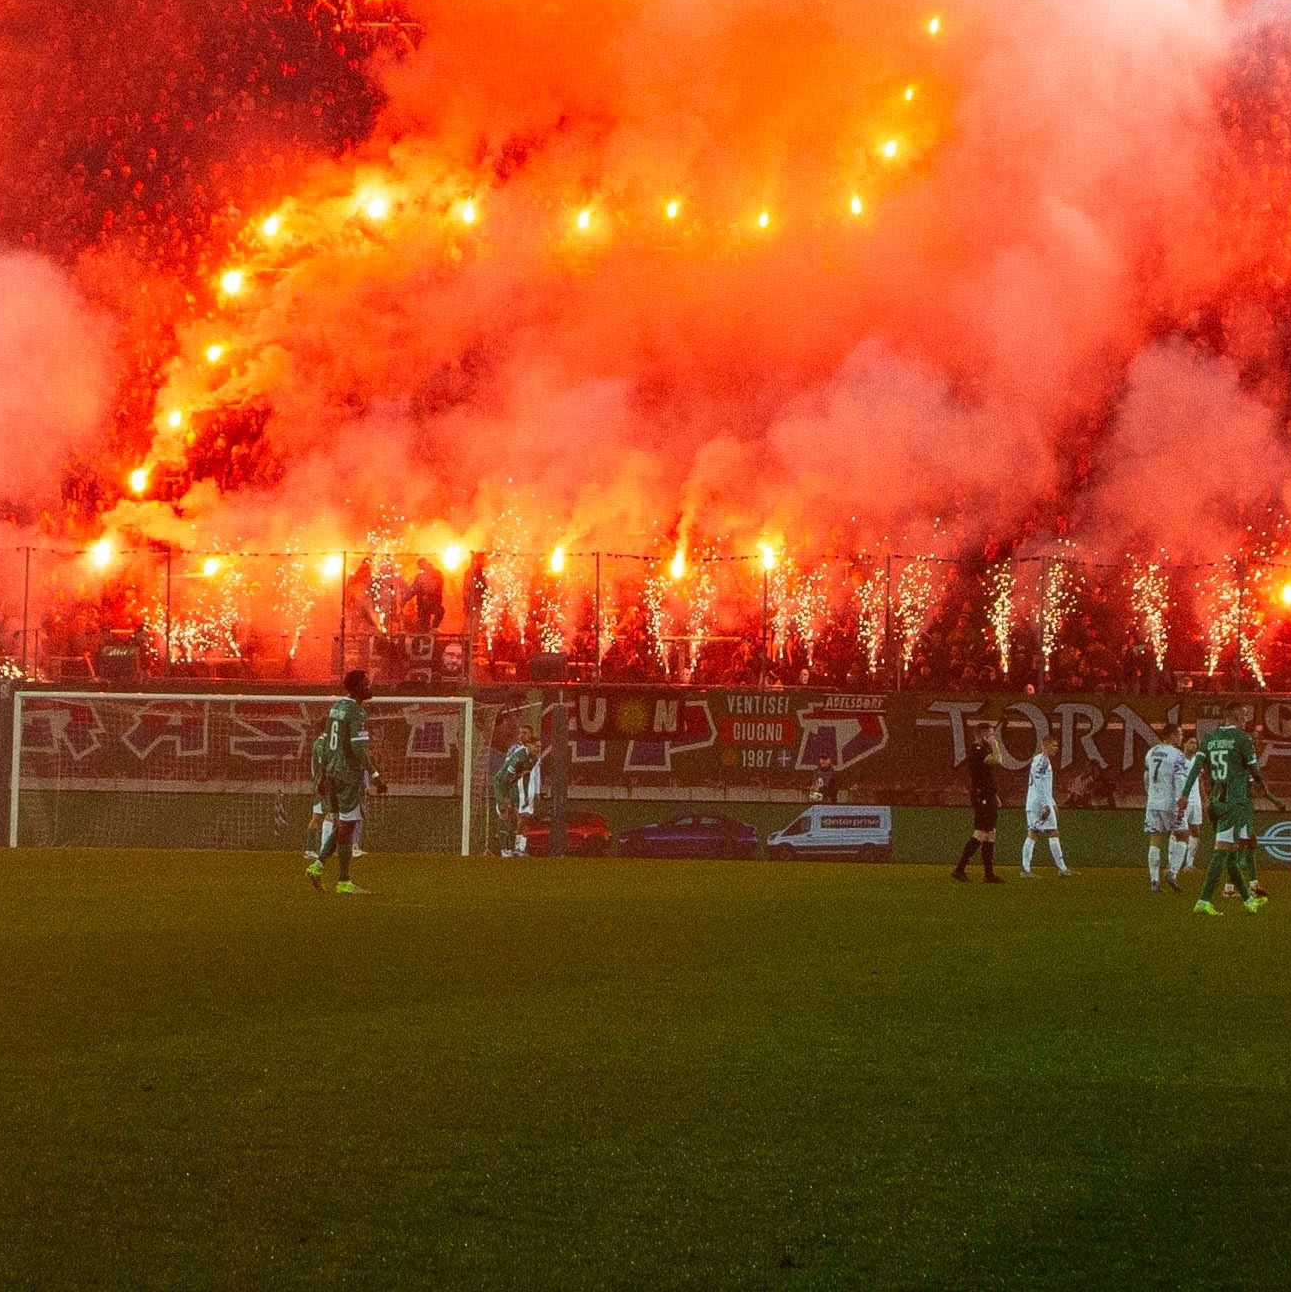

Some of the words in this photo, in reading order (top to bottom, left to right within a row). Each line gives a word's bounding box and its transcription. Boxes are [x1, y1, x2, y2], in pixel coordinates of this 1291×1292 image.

[727, 695, 790, 715] VENTISEI
[329, 720, 339, 751] 6
[732, 722, 783, 742] GIUGNO
[741, 749, 773, 768] 1987
[1209, 750, 1229, 780] 55
[1153, 758, 1162, 783] 7
